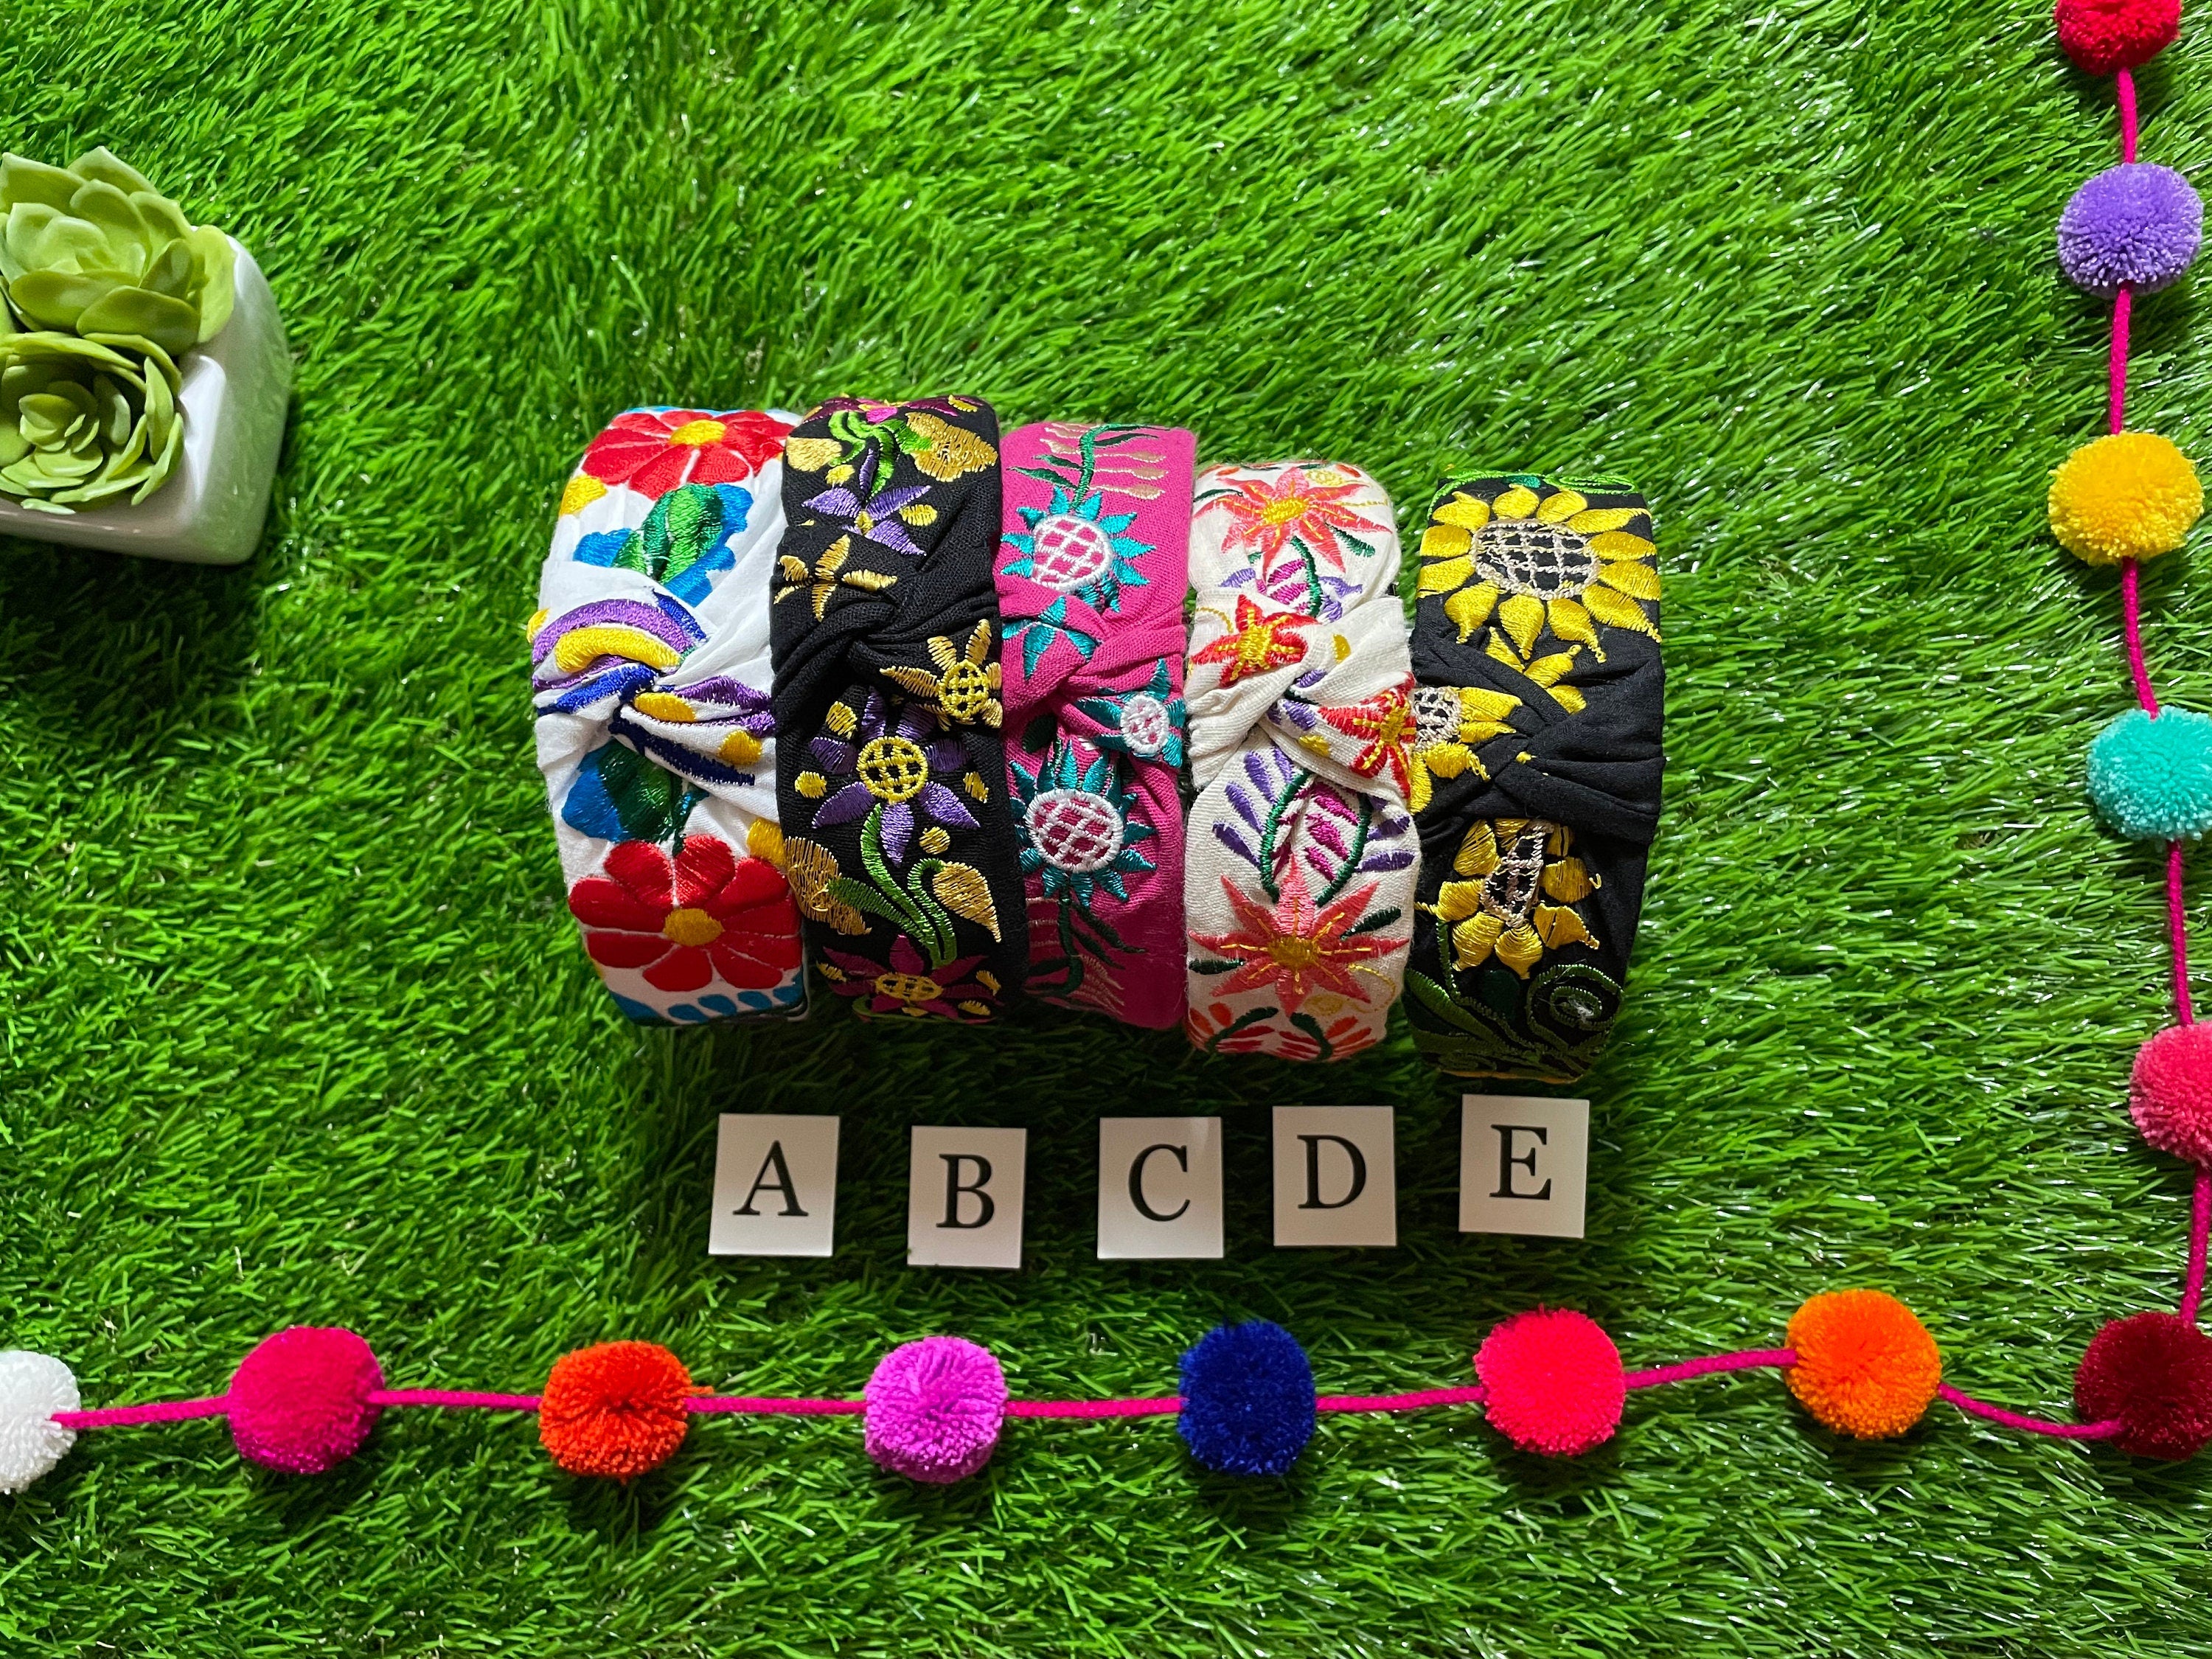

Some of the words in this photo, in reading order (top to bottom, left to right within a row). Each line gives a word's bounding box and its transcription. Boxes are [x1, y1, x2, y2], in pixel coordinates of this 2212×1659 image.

[732, 1140, 809, 1217] A
[936, 1153, 995, 1229] B
[1128, 1143, 1191, 1222] C
[1296, 1134, 1367, 1210] D
[1489, 1124, 1552, 1201] E
